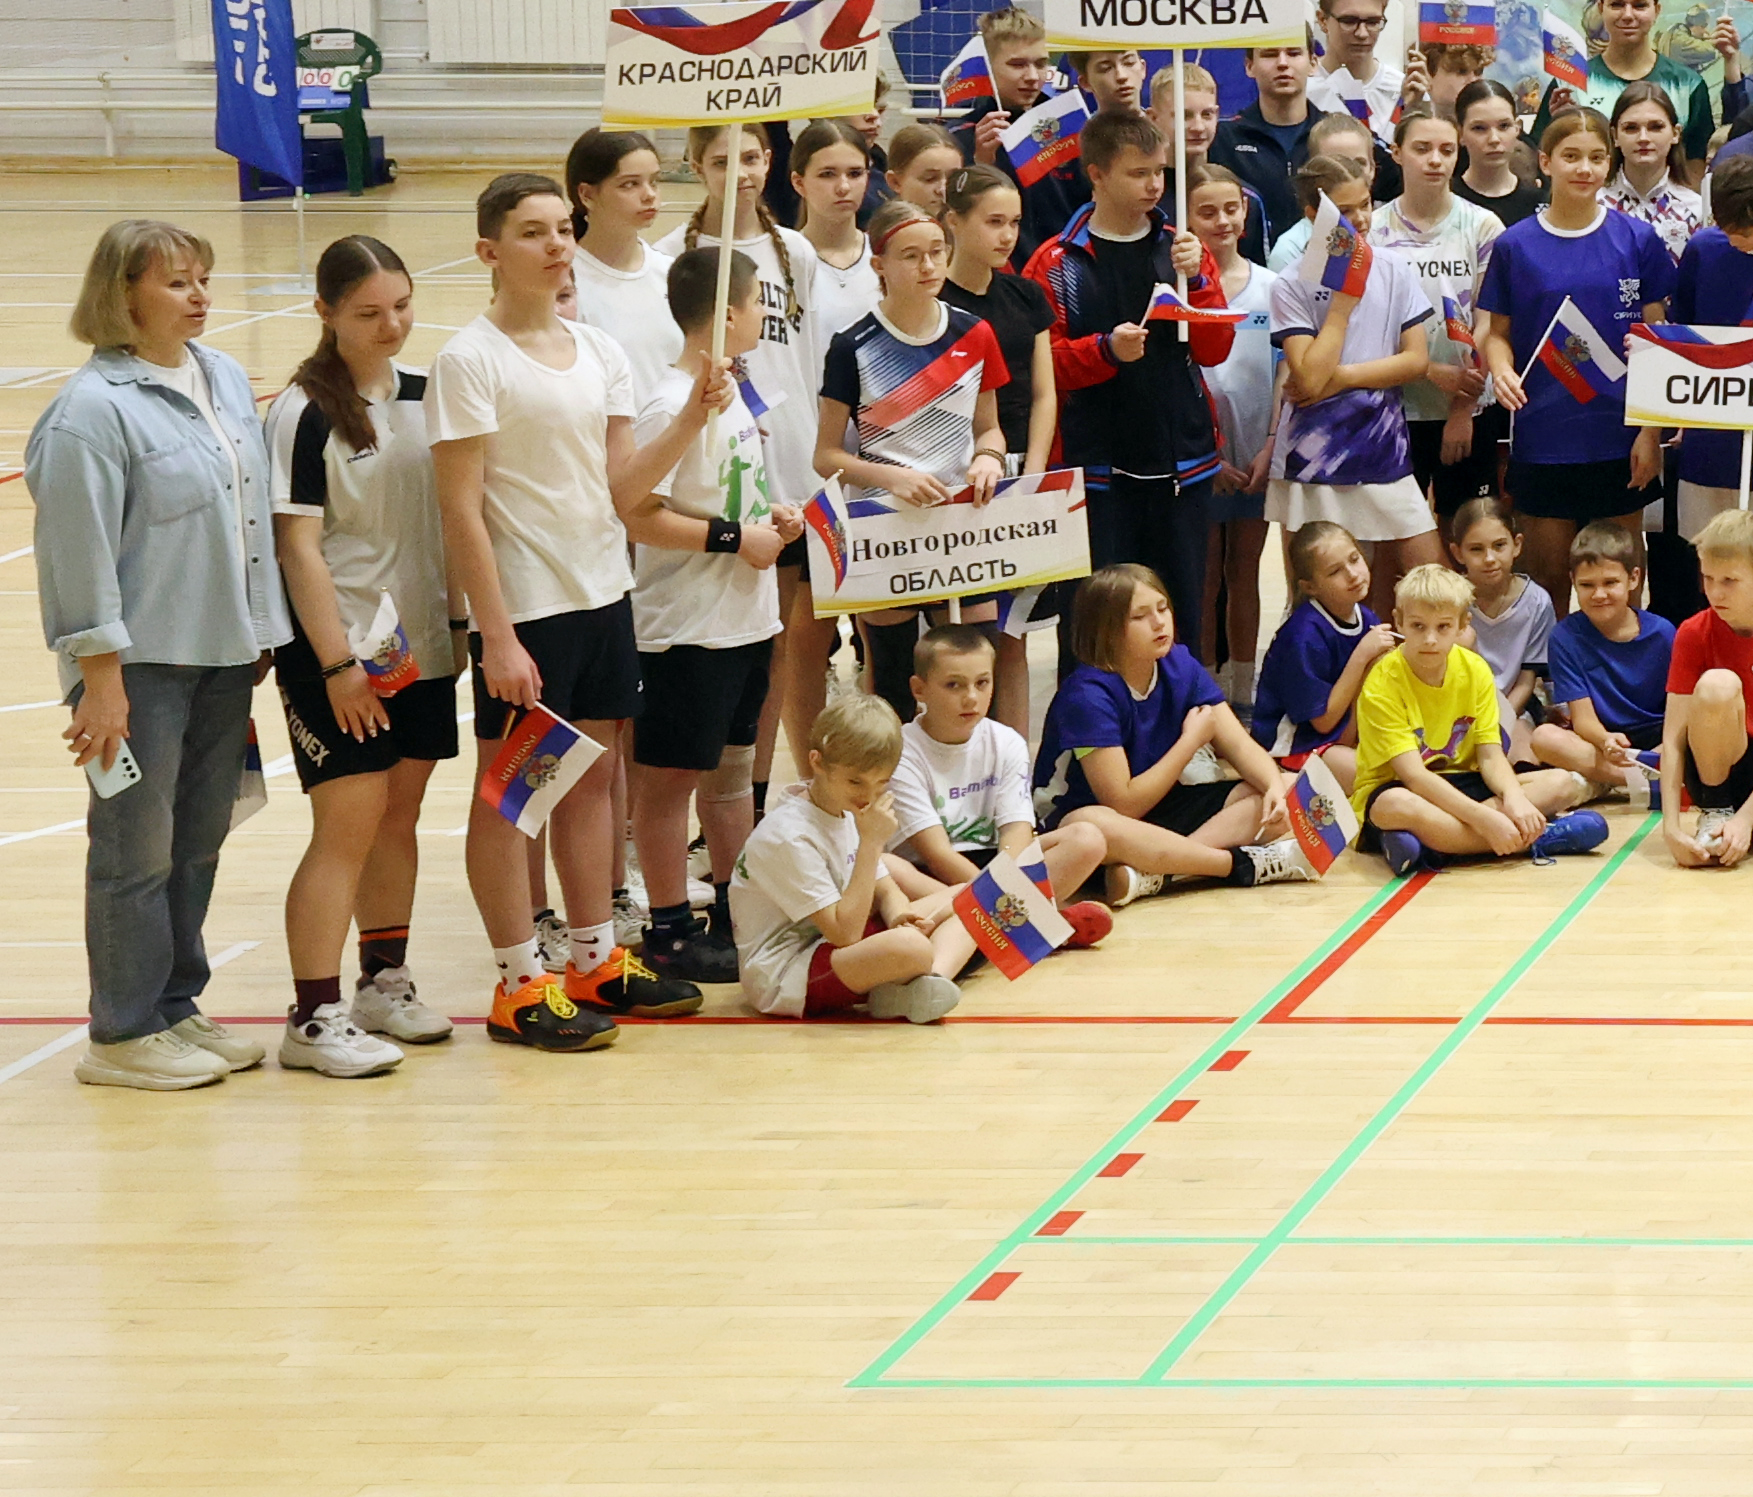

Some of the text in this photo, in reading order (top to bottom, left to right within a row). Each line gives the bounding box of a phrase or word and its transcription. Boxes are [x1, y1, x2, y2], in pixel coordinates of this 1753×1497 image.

[618, 46, 868, 86] КРАСНОДАРСКИЙ
[706, 83, 782, 111] КРАЙ
[1416, 260, 1472, 277] YONEX
[851, 517, 1059, 564] Новгородская
[889, 558, 1017, 595] ОБЛАСТЬ
[287, 705, 330, 768] YONEX
[970, 907, 1009, 952] РОССИЯ
